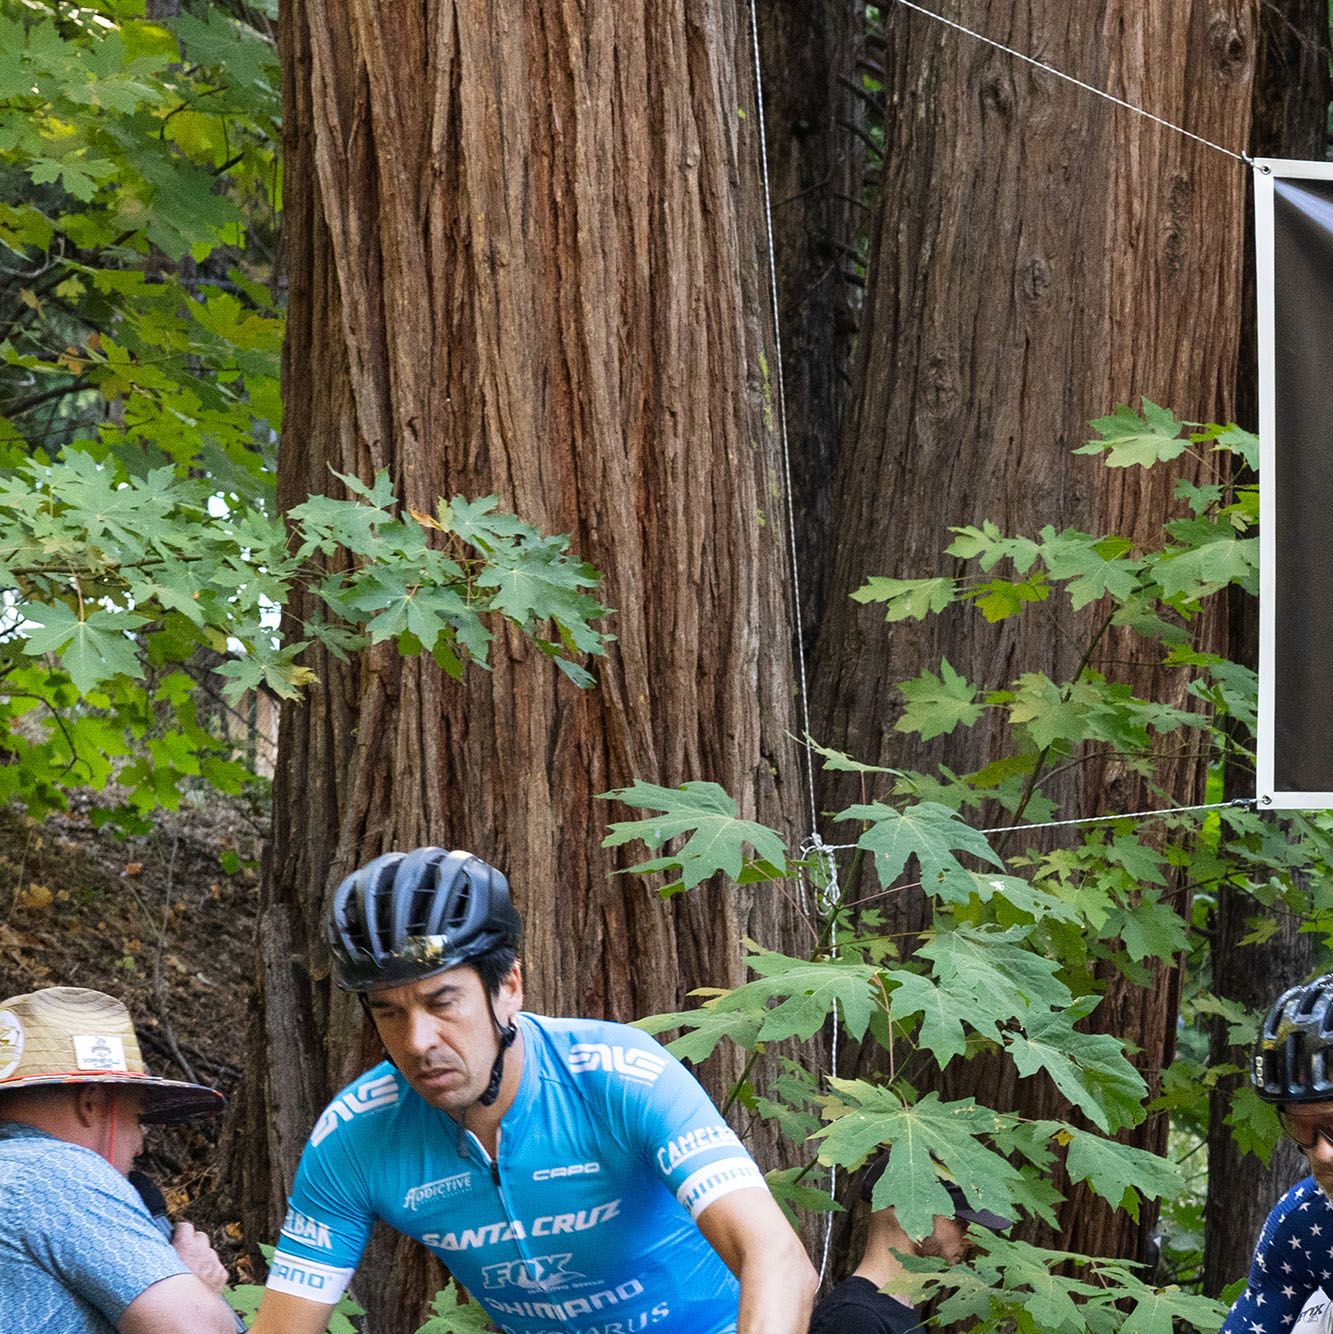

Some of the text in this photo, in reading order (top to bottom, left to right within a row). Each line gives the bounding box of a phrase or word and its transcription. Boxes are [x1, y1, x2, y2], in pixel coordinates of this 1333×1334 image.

[532, 1162, 600, 1181] CAPO
[421, 1198, 623, 1252] SANTA CRUZ
[481, 1252, 586, 1292] FOX
[484, 1277, 645, 1322] SHIMANO
